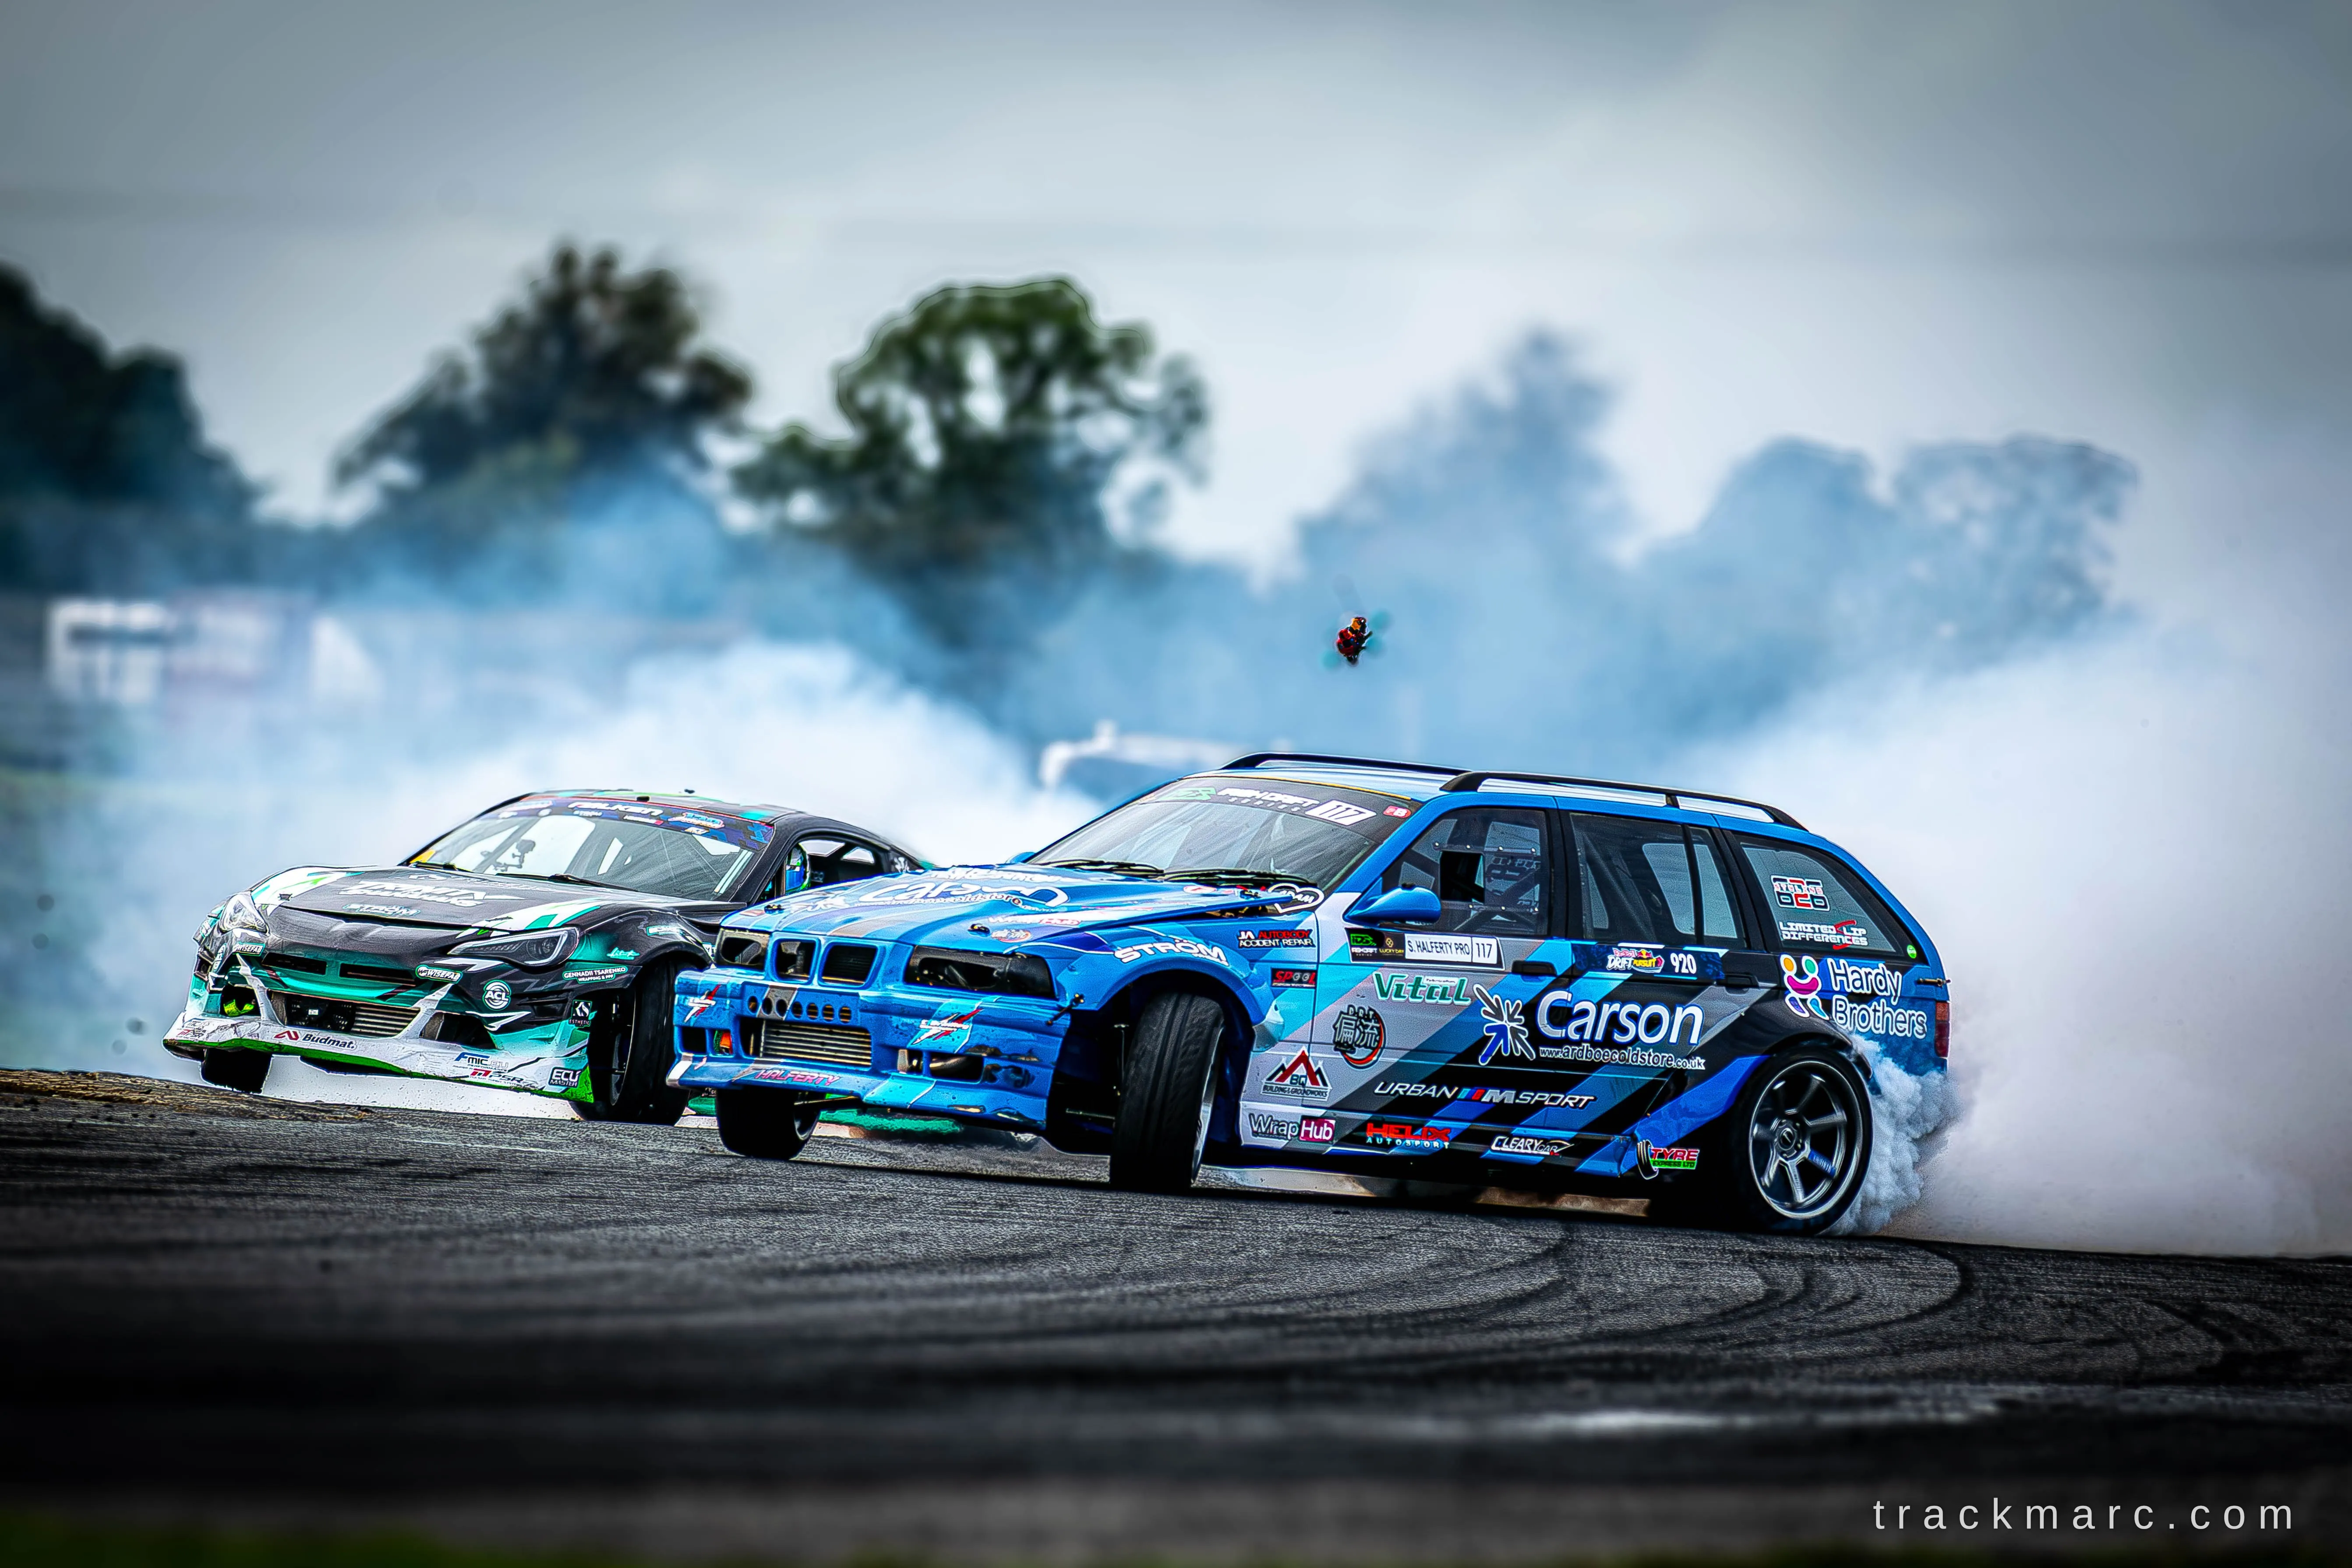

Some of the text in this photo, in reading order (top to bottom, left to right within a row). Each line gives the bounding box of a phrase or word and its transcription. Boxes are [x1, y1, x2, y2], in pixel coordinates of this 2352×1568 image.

[1239, 931, 1255, 939] JA
[1779, 921, 1836, 934] LIMITED
[1781, 931, 1868, 946] DIFFERENCES
[1114, 938, 1228, 964] STRÖM
[1417, 940, 1453, 955] HALFERTY
[1455, 943, 1470, 956] PRO
[1475, 943, 1493, 958] 117
[1606, 955, 1633, 970] DRIFT
[1670, 953, 1697, 974] 920
[427, 969, 461, 980] WISEFAB
[594, 967, 626, 975] TSARENKO
[1374, 973, 1471, 1002] Vital
[1827, 958, 1902, 1004] Hardy
[485, 990, 509, 1001] ACL
[1538, 990, 1706, 1046] Carson
[1832, 996, 1927, 1039] Brothers
[1539, 1042, 1706, 1070] www.ardboecoldstore.co.uk
[552, 1069, 582, 1081] ECU
[755, 1069, 840, 1086] HALFERTY
[1374, 1081, 1459, 1099] URBAN
[1515, 1092, 1595, 1108] SPORT
[1366, 1123, 1452, 1142] HELIX
[1367, 1137, 1450, 1150] AUTOSPORT
[1651, 1148, 1700, 1162] TYRE
